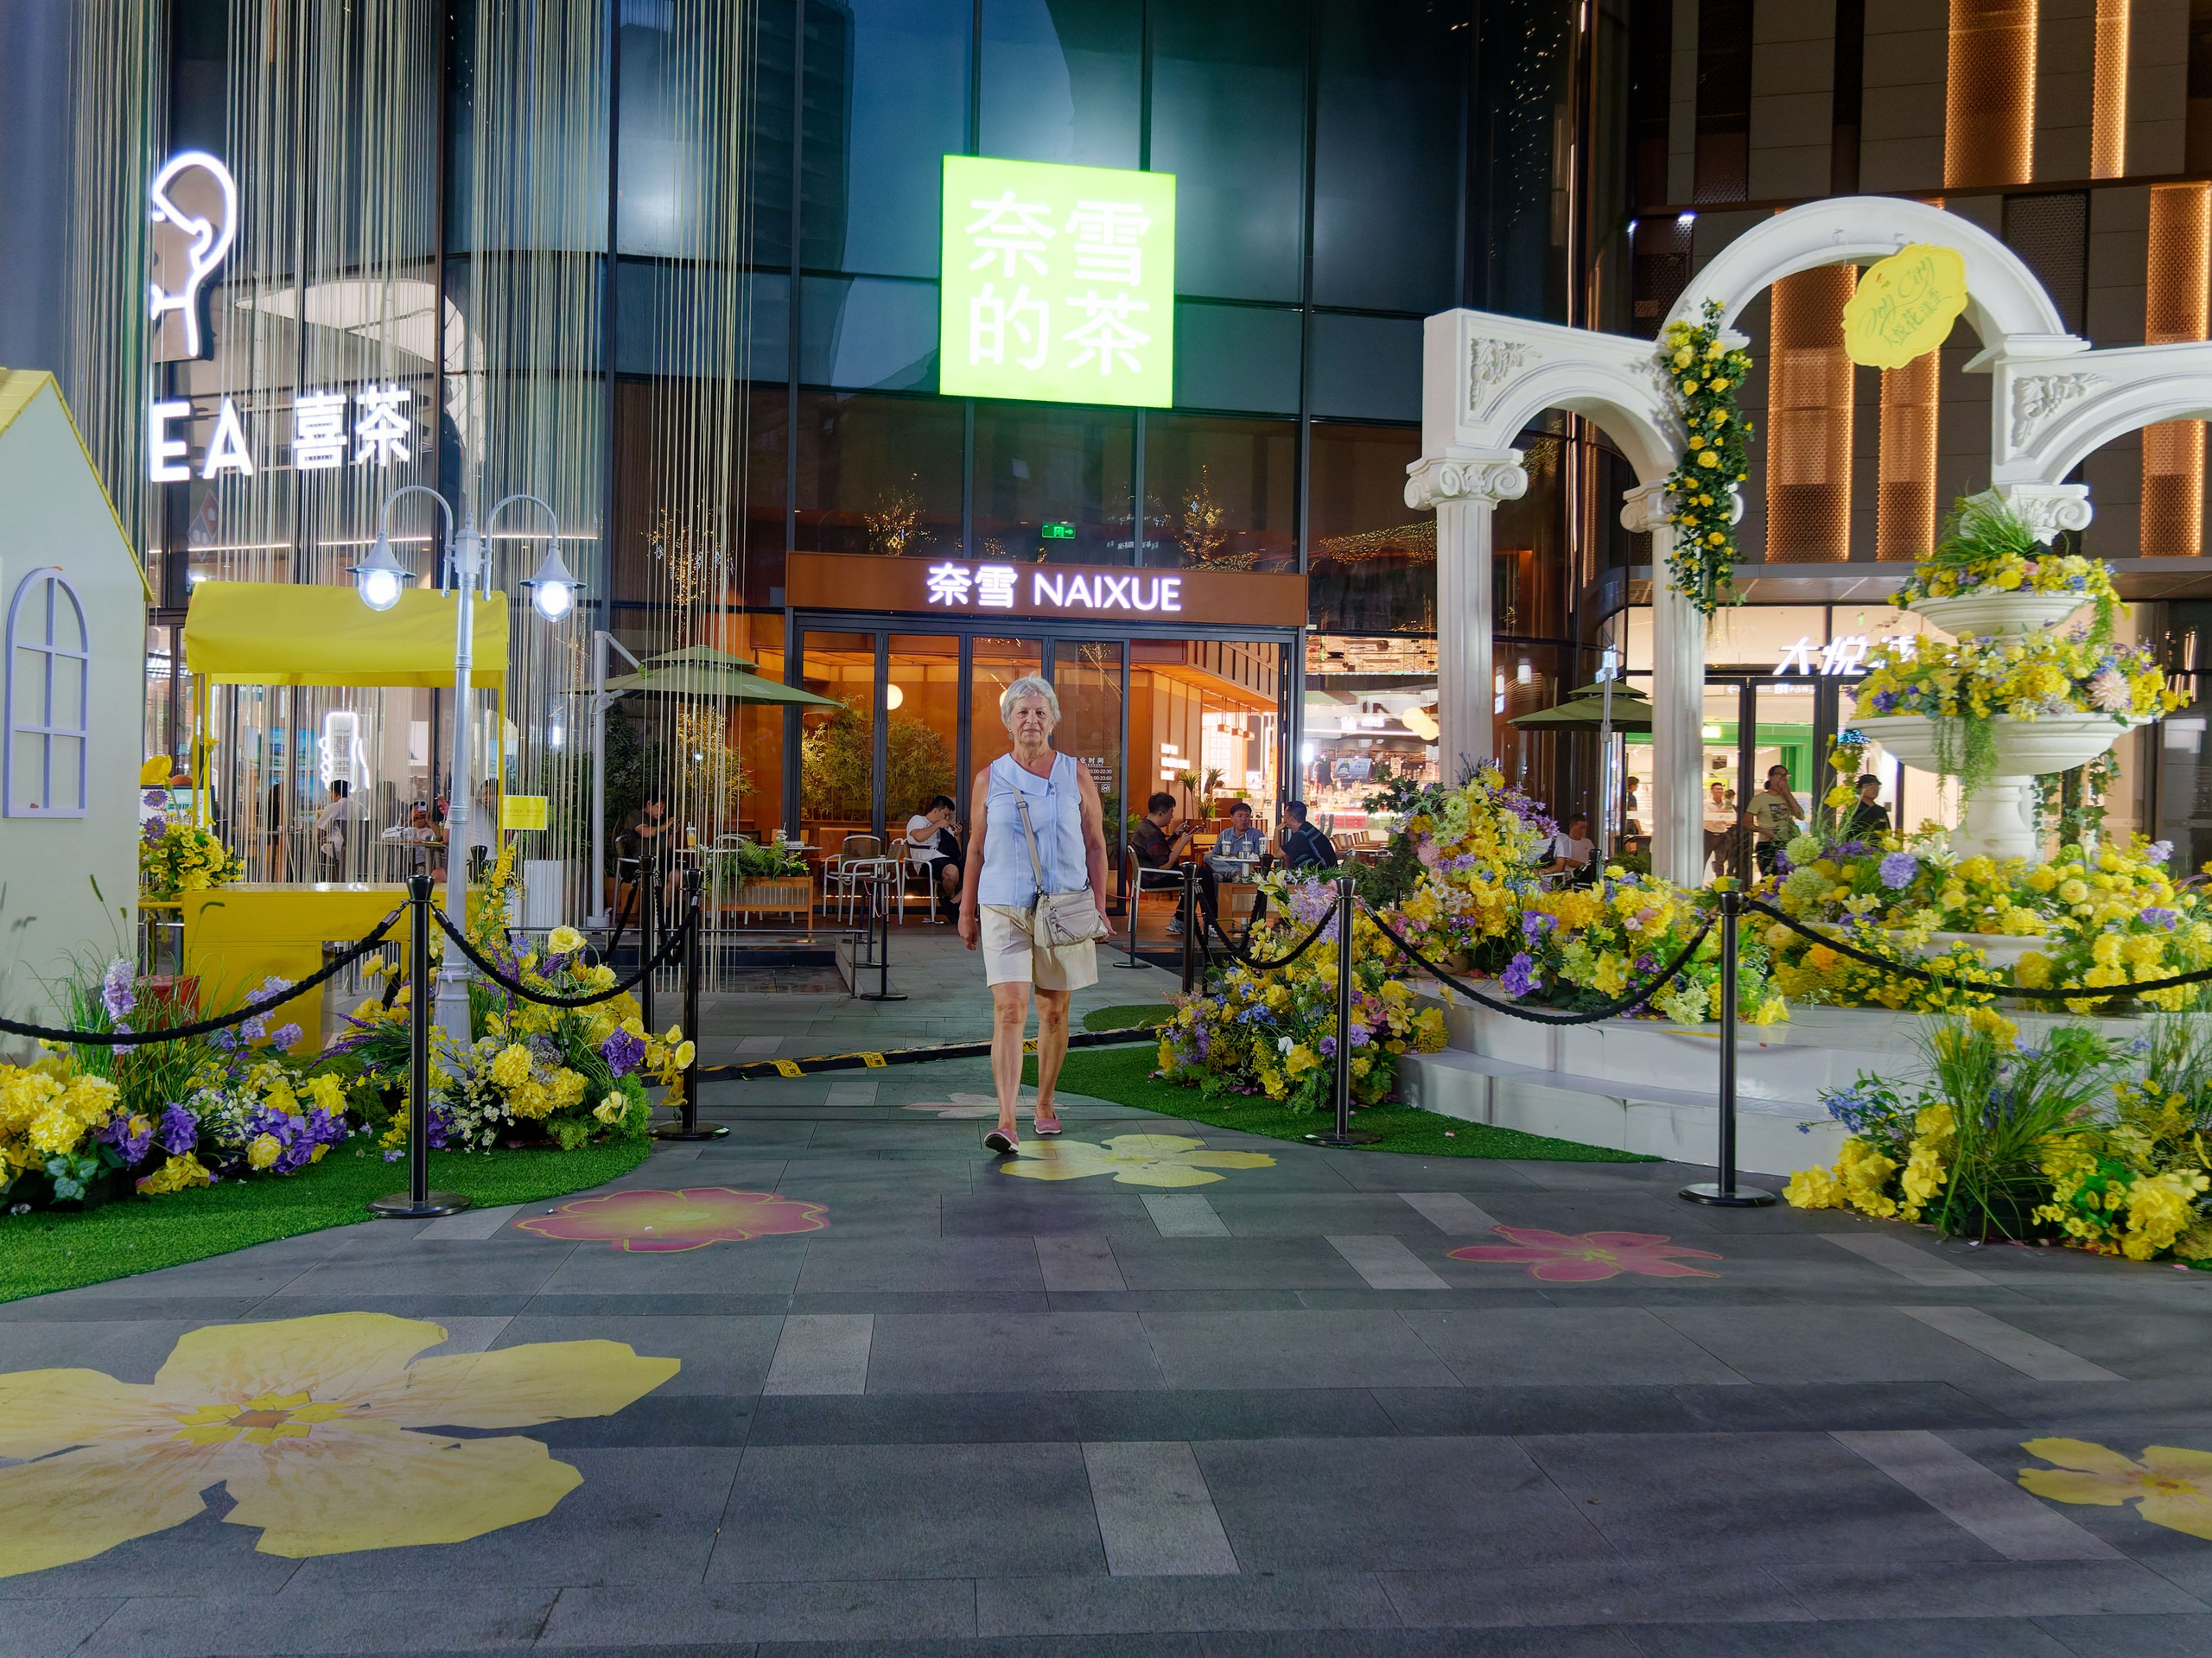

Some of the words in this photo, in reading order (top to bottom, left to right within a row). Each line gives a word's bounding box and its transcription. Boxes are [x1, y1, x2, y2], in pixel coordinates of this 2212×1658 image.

[964, 189, 1153, 287] 奈雪
[968, 282, 1152, 377] 的茶
[292, 382, 411, 470] 喜茶
[926, 562, 1019, 608] 奈雪
[1033, 573, 1182, 612] NAIXUE
[1079, 756, 1104, 765] 业时间
